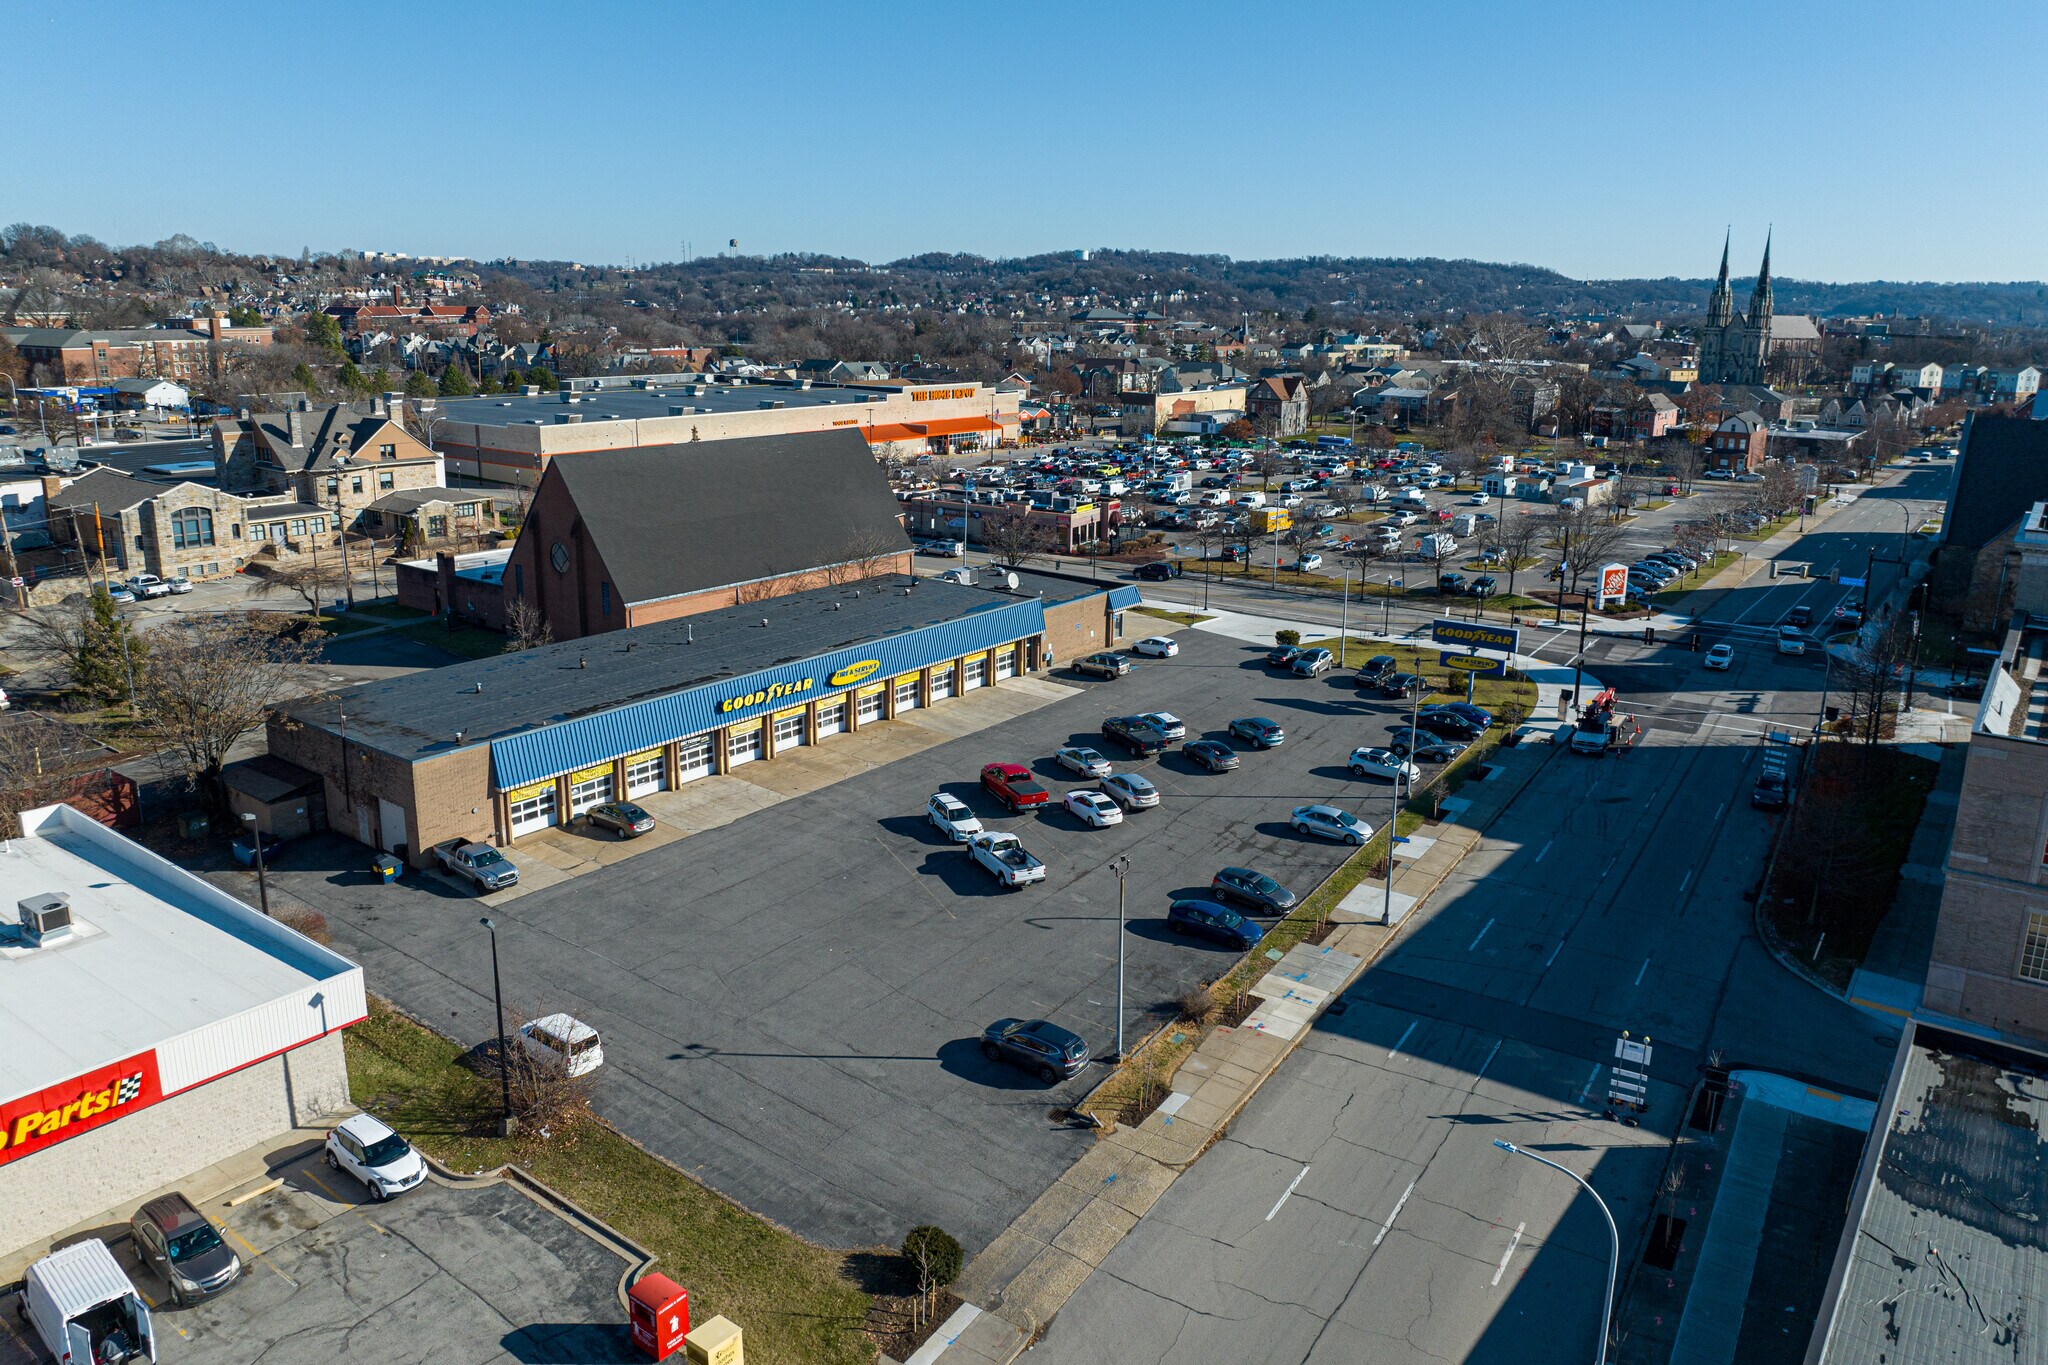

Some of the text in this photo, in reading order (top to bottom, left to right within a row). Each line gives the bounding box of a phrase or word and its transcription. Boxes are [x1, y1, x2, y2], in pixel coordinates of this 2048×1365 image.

[911, 387, 975, 401] THE HOME DEPOT
[1436, 627, 1513, 645] GOODYEAR
[836, 671, 849, 679] TIRE
[854, 663, 878, 674] SERVICE
[722, 678, 813, 712] GOODYEAR
[13, 1089, 111, 1146] Parts
